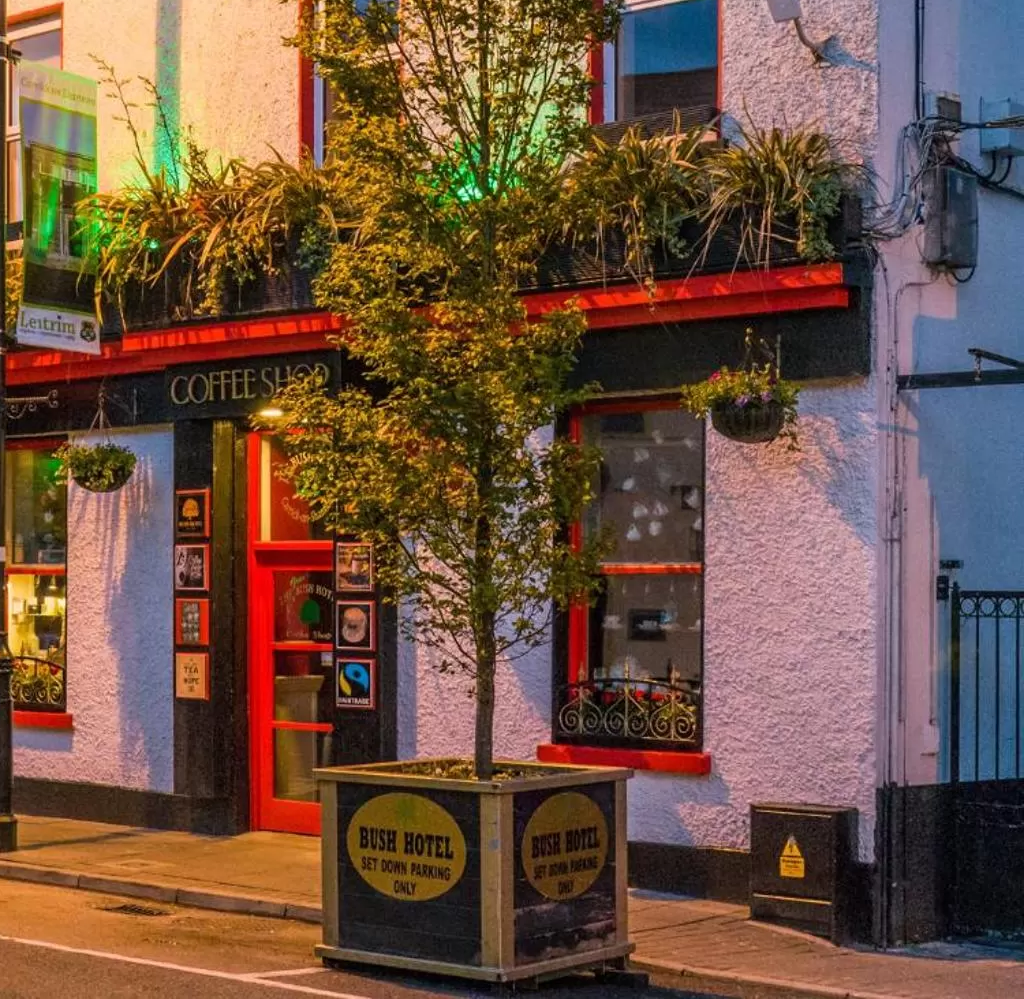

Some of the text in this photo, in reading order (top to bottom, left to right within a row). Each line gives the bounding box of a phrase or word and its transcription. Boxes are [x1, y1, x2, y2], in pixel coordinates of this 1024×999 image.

[20, 310, 75, 335] Leitrim
[170, 368, 257, 405] COFFEE
[359, 826, 454, 859] BUSH HOTEL
[531, 826, 600, 858] BUSH HOTEL
[361, 857, 451, 881] SET DOWN PARKING
[533, 867, 546, 880] SET
[393, 879, 416, 895] ONLY
[557, 880, 575, 895] ONLY
